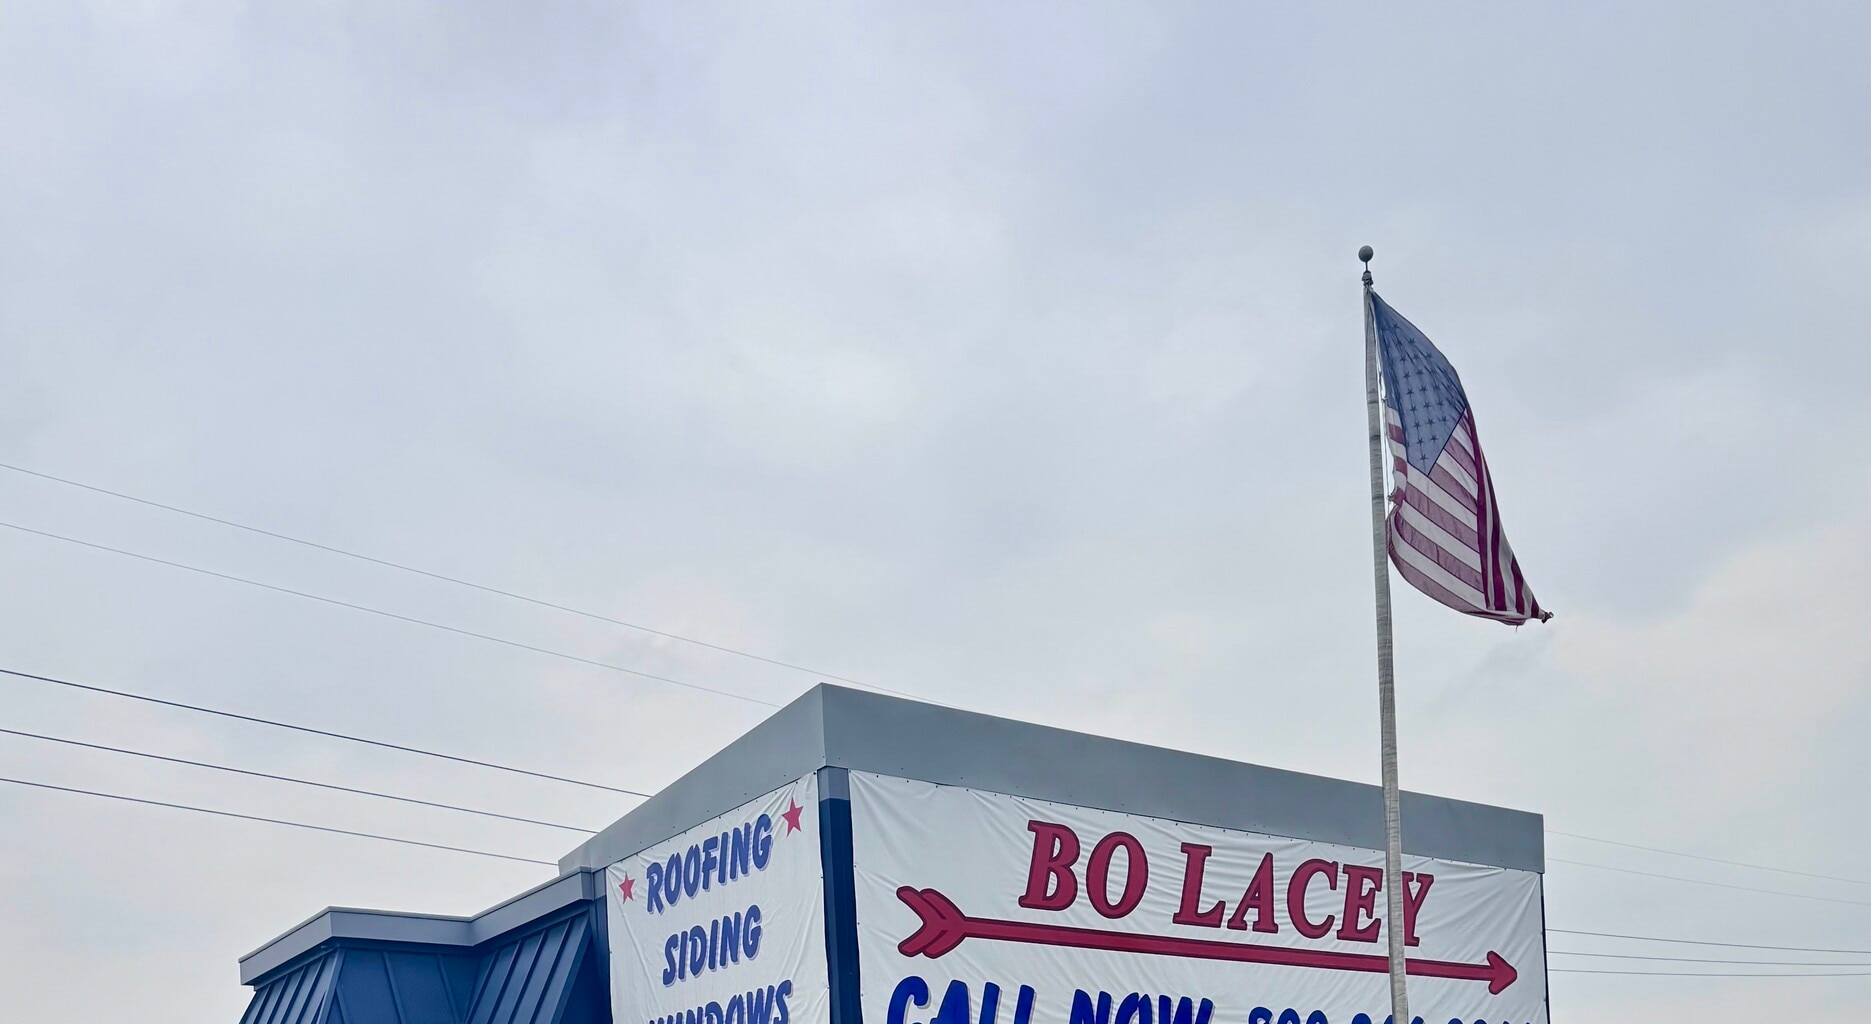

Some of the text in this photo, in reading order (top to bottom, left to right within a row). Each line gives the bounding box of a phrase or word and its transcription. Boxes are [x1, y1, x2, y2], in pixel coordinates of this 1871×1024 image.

[646, 813, 773, 915] ROOFING
[1018, 819, 1435, 948] BO LACEY
[662, 904, 763, 987] SIDING
